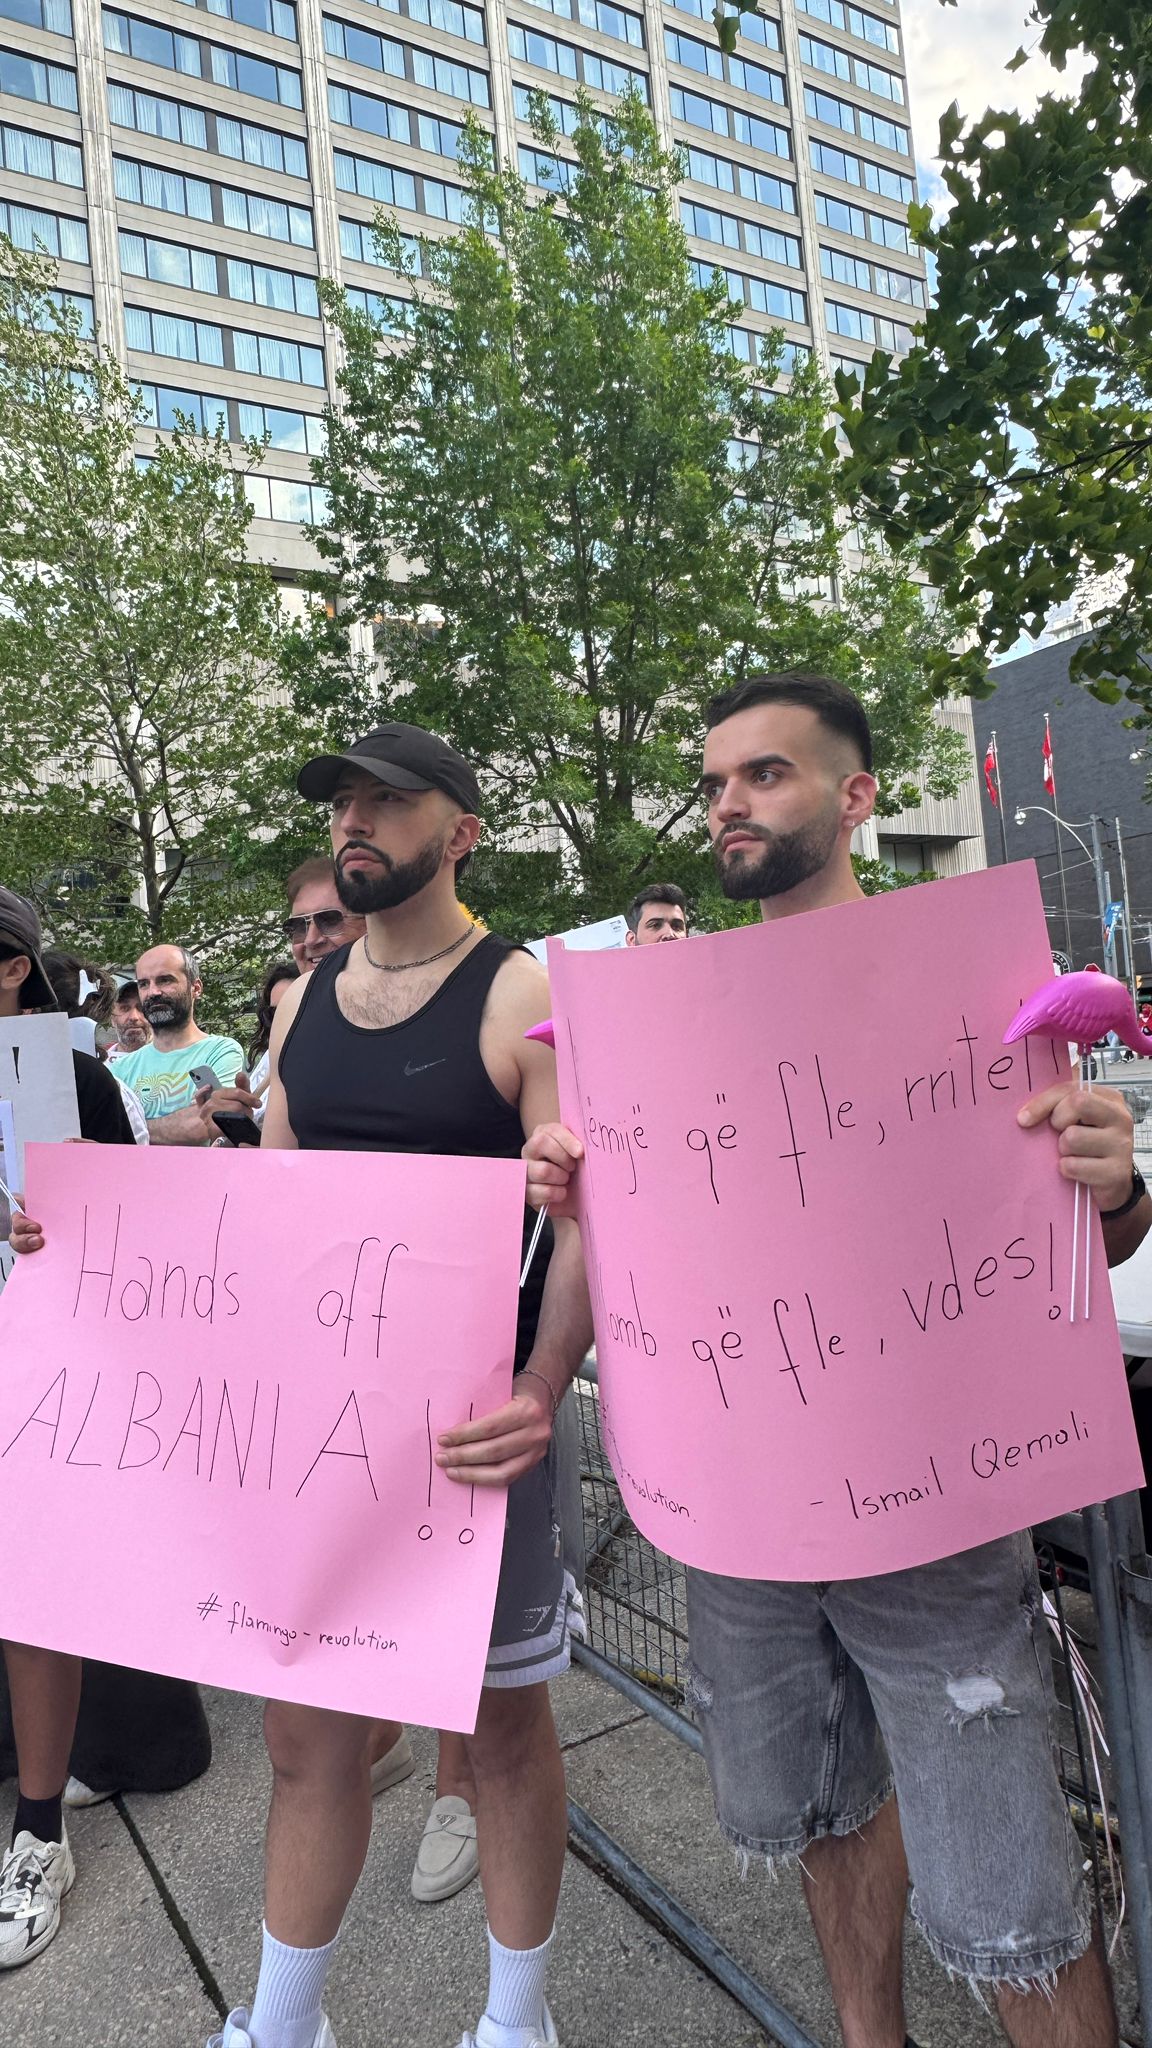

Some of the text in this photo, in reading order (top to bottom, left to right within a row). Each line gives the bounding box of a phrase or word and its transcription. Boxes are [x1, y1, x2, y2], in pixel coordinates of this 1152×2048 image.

[687, 1092, 738, 1205] që
[73, 1193, 409, 1358] Hands off
[692, 1305, 744, 1409] që
[845, 1456, 944, 1519] Ismail
